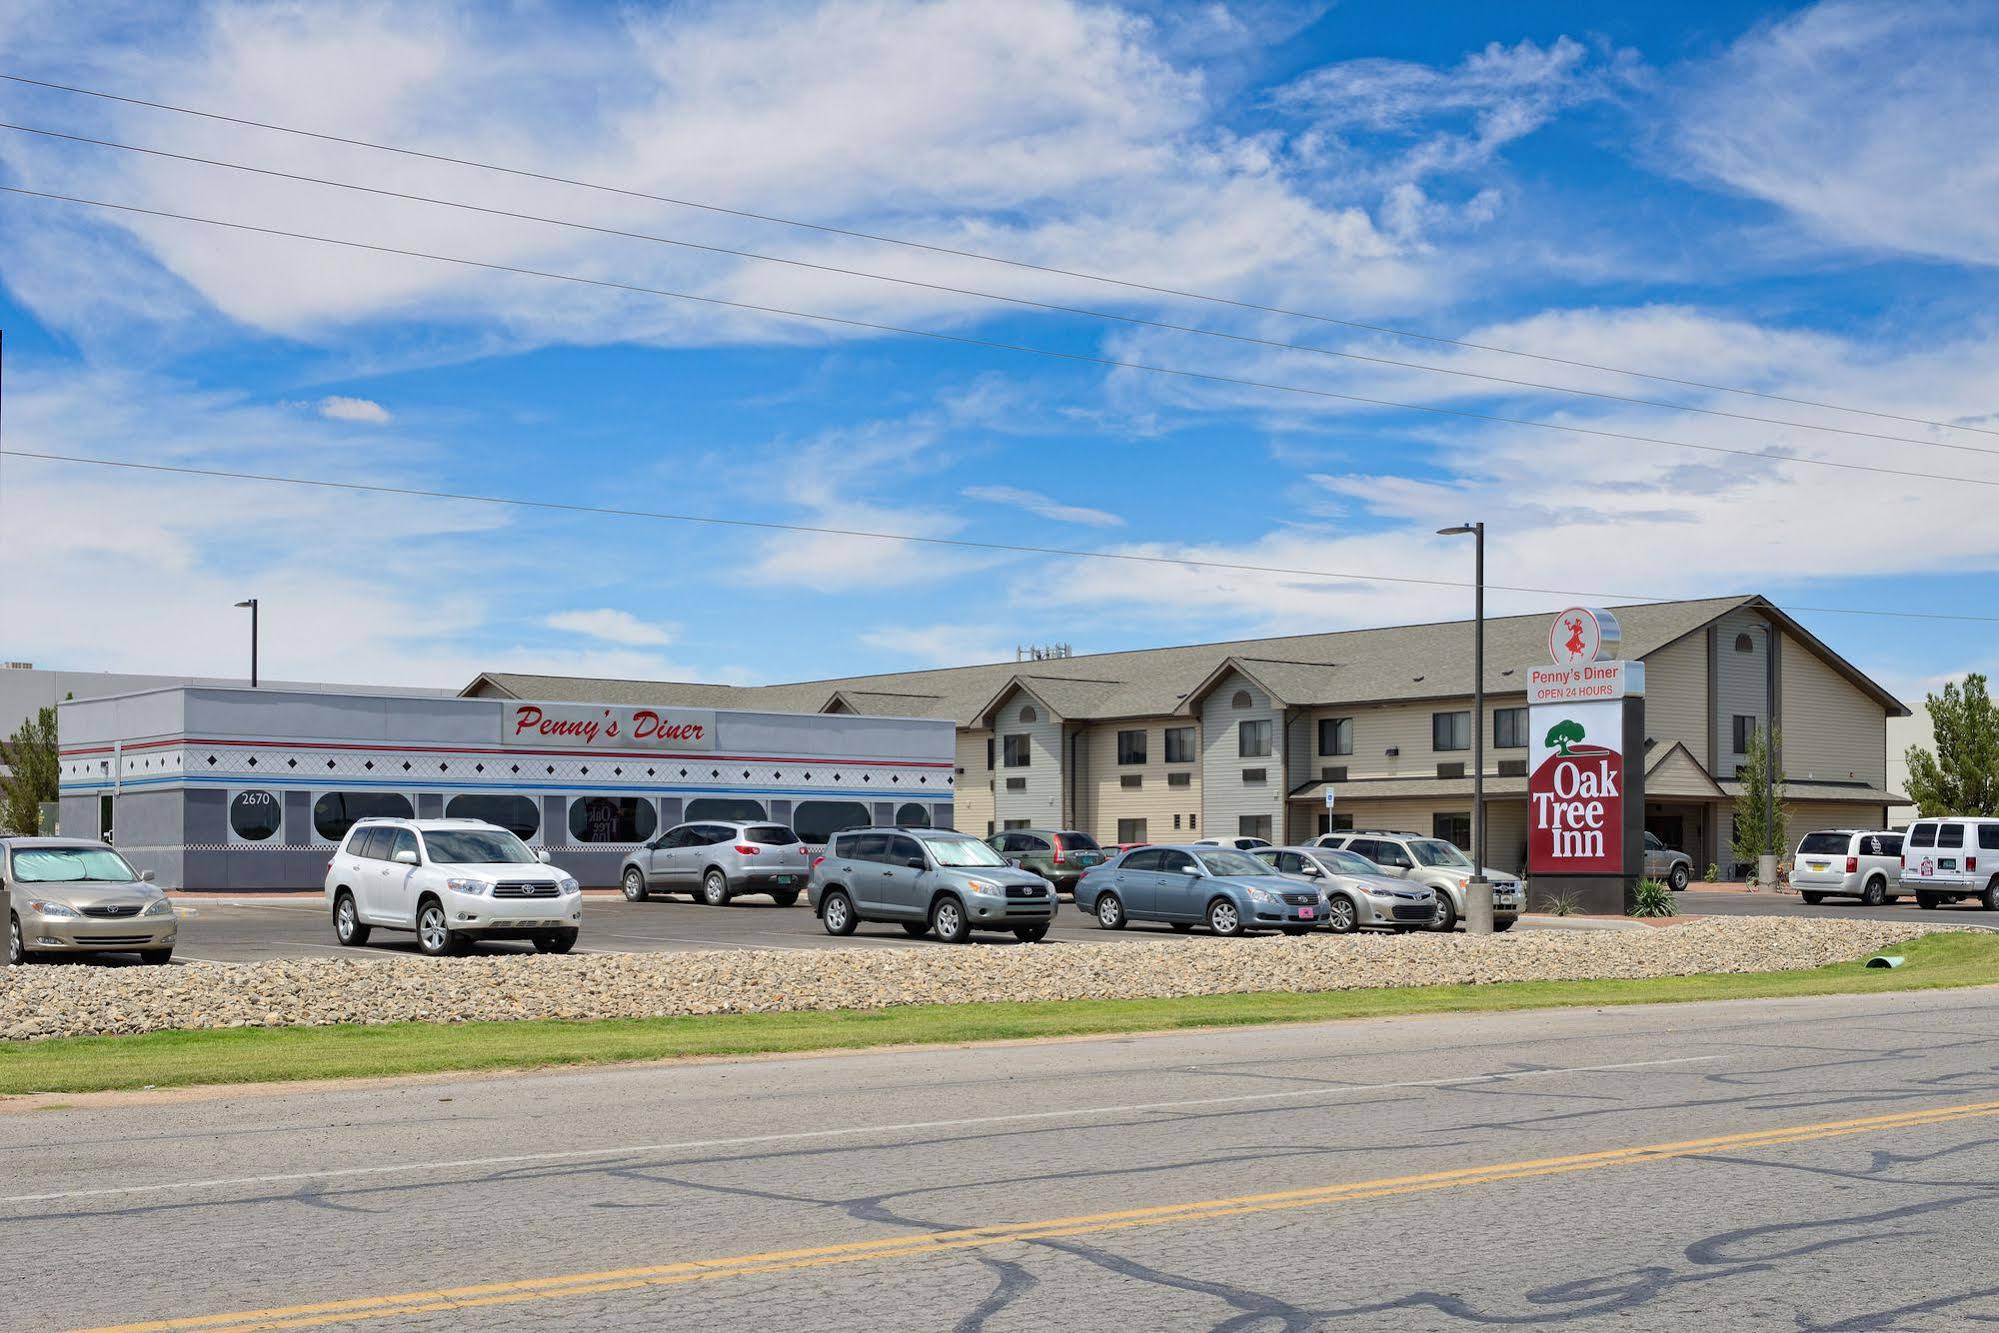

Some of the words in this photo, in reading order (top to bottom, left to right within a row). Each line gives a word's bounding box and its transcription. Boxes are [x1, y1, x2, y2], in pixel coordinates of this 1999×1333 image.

[1532, 668, 1580, 684] Penny's
[1584, 667, 1618, 680] Diner
[1537, 688, 1563, 699] OPEN
[1566, 687, 1576, 697] 24
[1579, 685, 1613, 695] HOURS
[516, 706, 620, 743] Penny's
[633, 711, 705, 740] Diner
[1553, 760, 1619, 799] Oak
[242, 793, 270, 805] 2670
[1533, 792, 1604, 829] Tree
[1552, 828, 1605, 857] Inn
